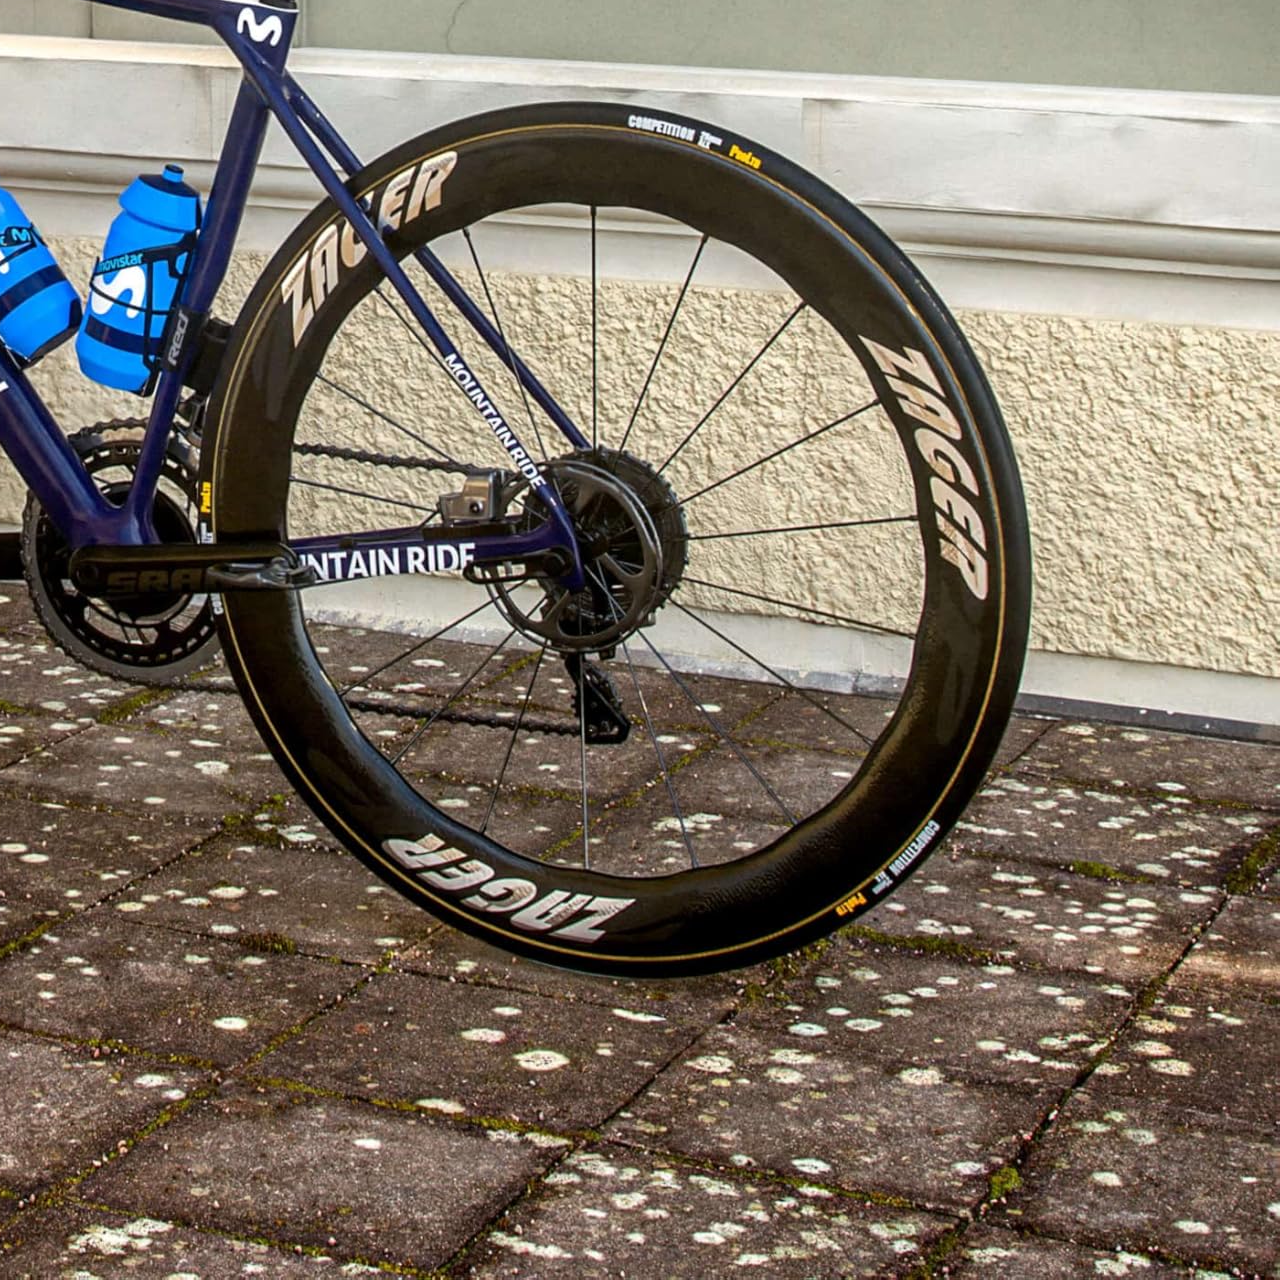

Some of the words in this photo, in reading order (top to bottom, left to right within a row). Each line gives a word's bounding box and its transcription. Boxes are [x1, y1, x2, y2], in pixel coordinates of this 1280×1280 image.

[627, 114, 696, 142] COMPETITION
[99, 252, 143, 273] movistar
[445, 353, 517, 449] MOUNTAIN
[509, 446, 547, 490] RIDE
[858, 334, 988, 601] ZAGER
[381, 832, 637, 944] ZAGER
[888, 820, 941, 876] COMPETITION
